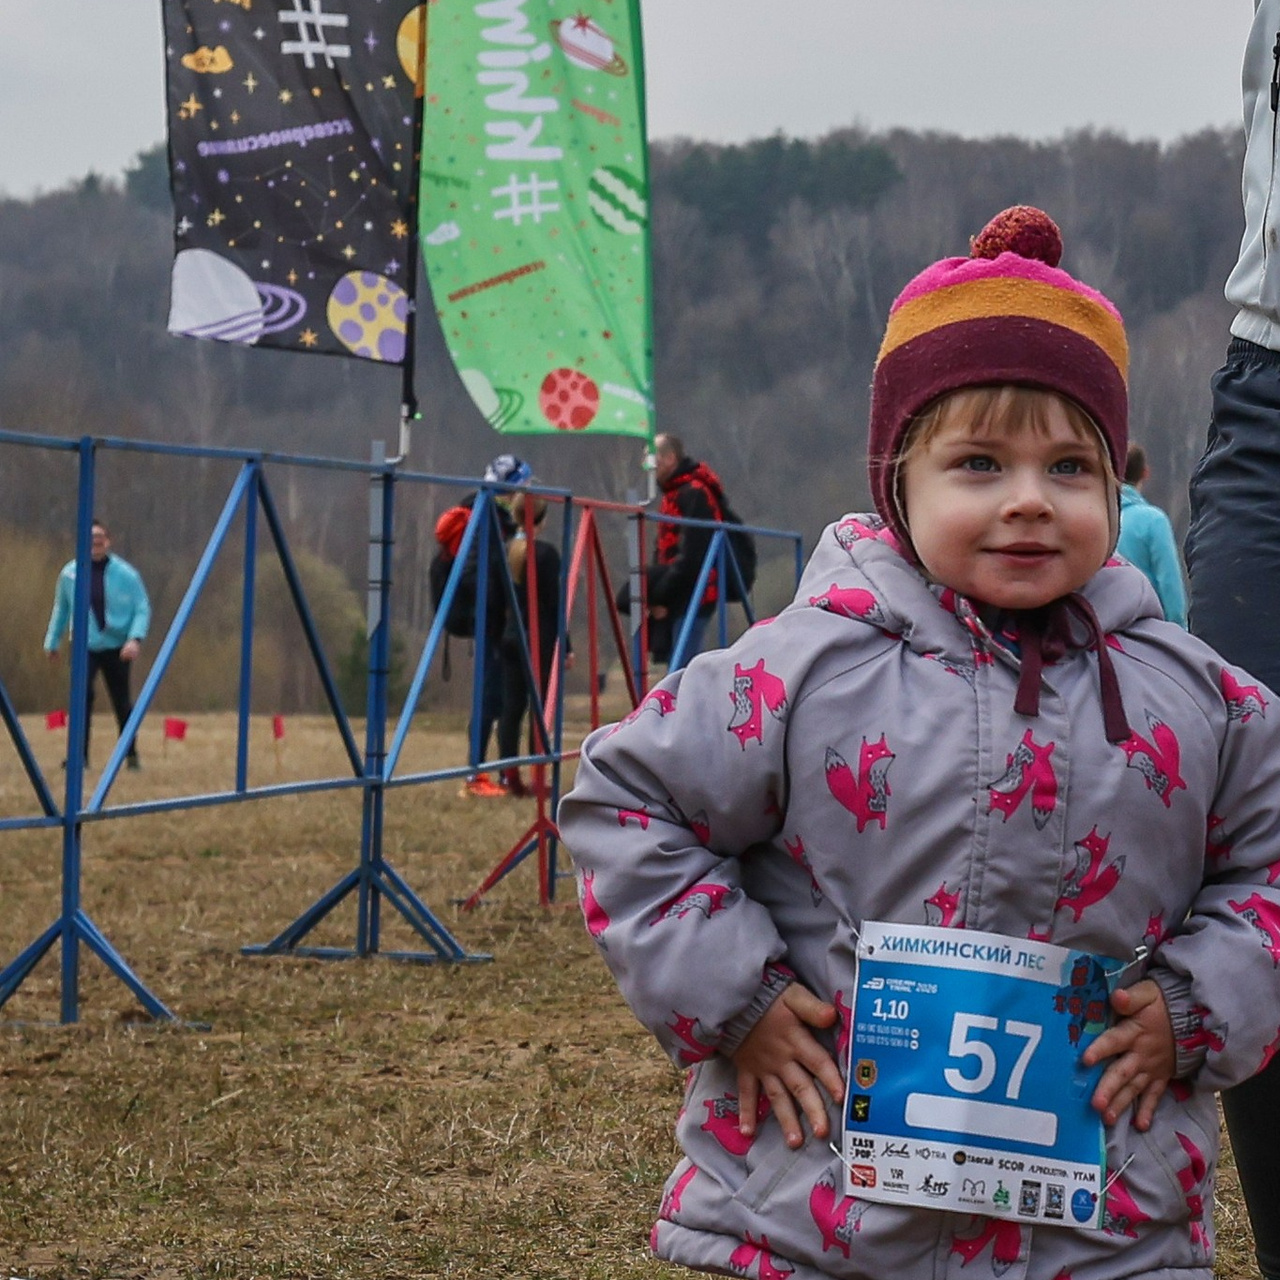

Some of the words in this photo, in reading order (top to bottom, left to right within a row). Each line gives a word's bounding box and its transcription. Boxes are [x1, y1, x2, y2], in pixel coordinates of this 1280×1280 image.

[880, 934, 1012, 966] ХИМКИНСКИЙ
[1014, 950, 1047, 971] ЛЕС
[872, 997, 909, 1021] 1,10
[943, 1011, 1043, 1101] 57
[998, 1159, 1025, 1172] SCOR
